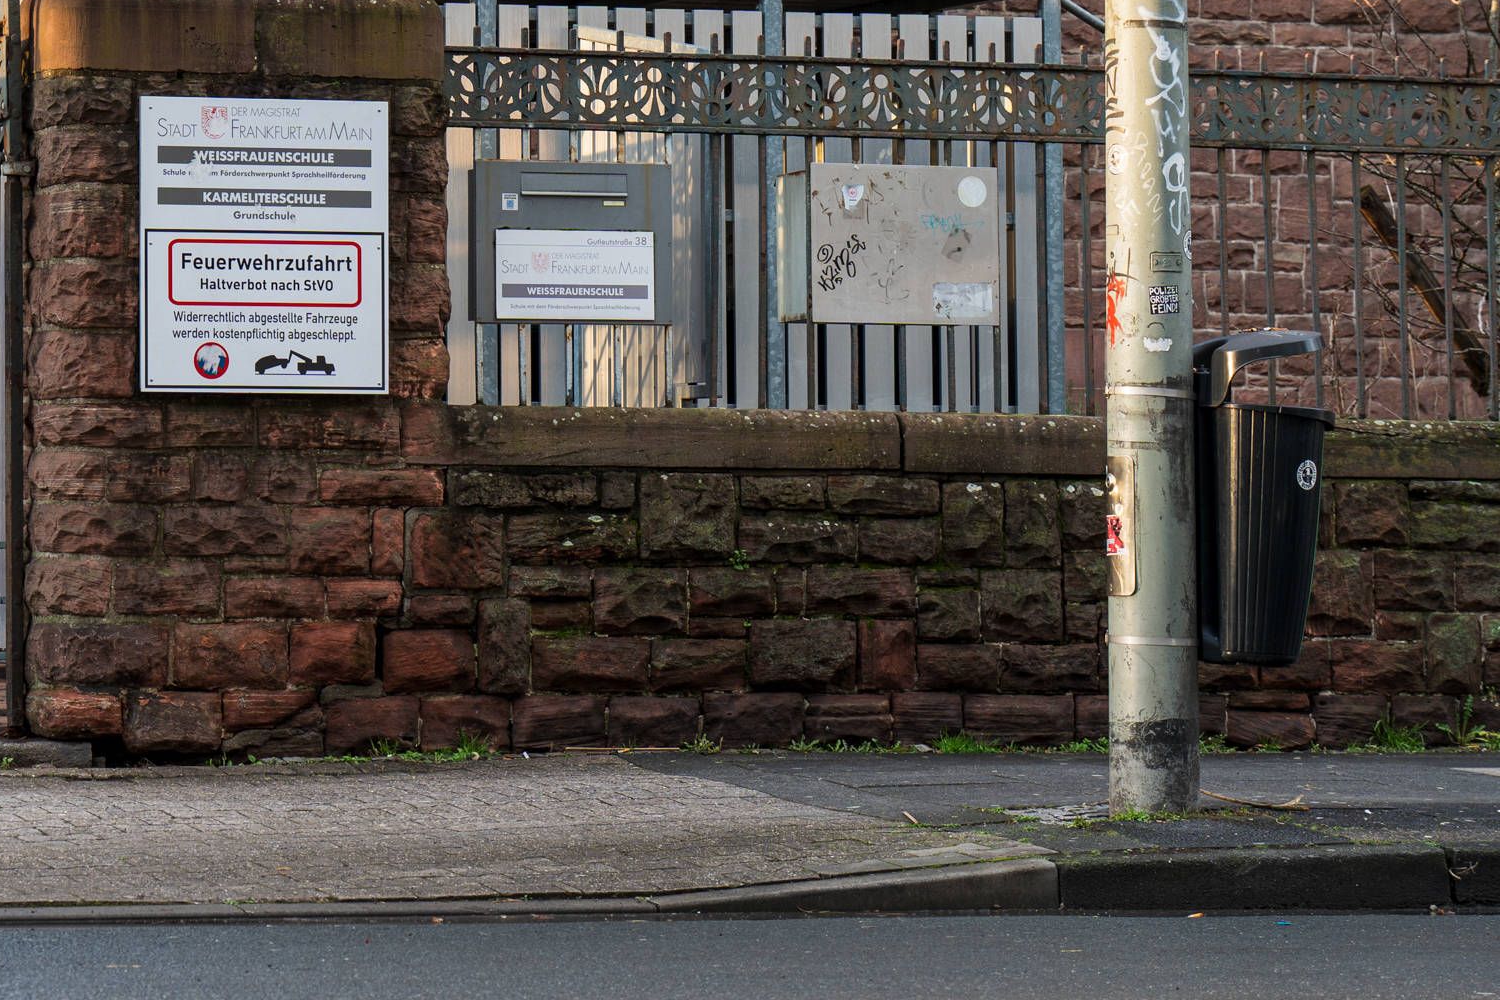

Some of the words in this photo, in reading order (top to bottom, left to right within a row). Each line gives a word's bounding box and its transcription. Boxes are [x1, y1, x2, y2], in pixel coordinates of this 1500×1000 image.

[231, 107, 248, 117] DER
[250, 108, 300, 118] MAGISTRAT
[196, 150, 334, 164] WEISSFRAUENSCHULE
[162, 168, 186, 177] Schule
[220, 168, 290, 179] Förderschwerpunkt
[291, 170, 366, 180] Sprachheilförderung
[203, 191, 326, 205] KARMELITERSCHULE
[233, 210, 296, 221] Grundschule
[635, 236, 647, 246] 38
[181, 252, 352, 272] Feuerwehrzufahrt
[200, 278, 268, 291] Haltverbot
[270, 279, 300, 291] nach
[304, 280, 334, 292] StVO
[527, 286, 624, 296] WEISSFRAUENSCHULE
[1149, 286, 1178, 295] POLIZEI
[1152, 303, 1178, 314] FEIND!
[173, 310, 246, 324] Widerrechtlich
[248, 312, 303, 326] abgestellte
[306, 312, 358, 327] Fahrzeuge
[172, 328, 210, 339] werden
[213, 328, 285, 342] kostenpflichtig
[288, 329, 356, 343] abgeschleppt.
